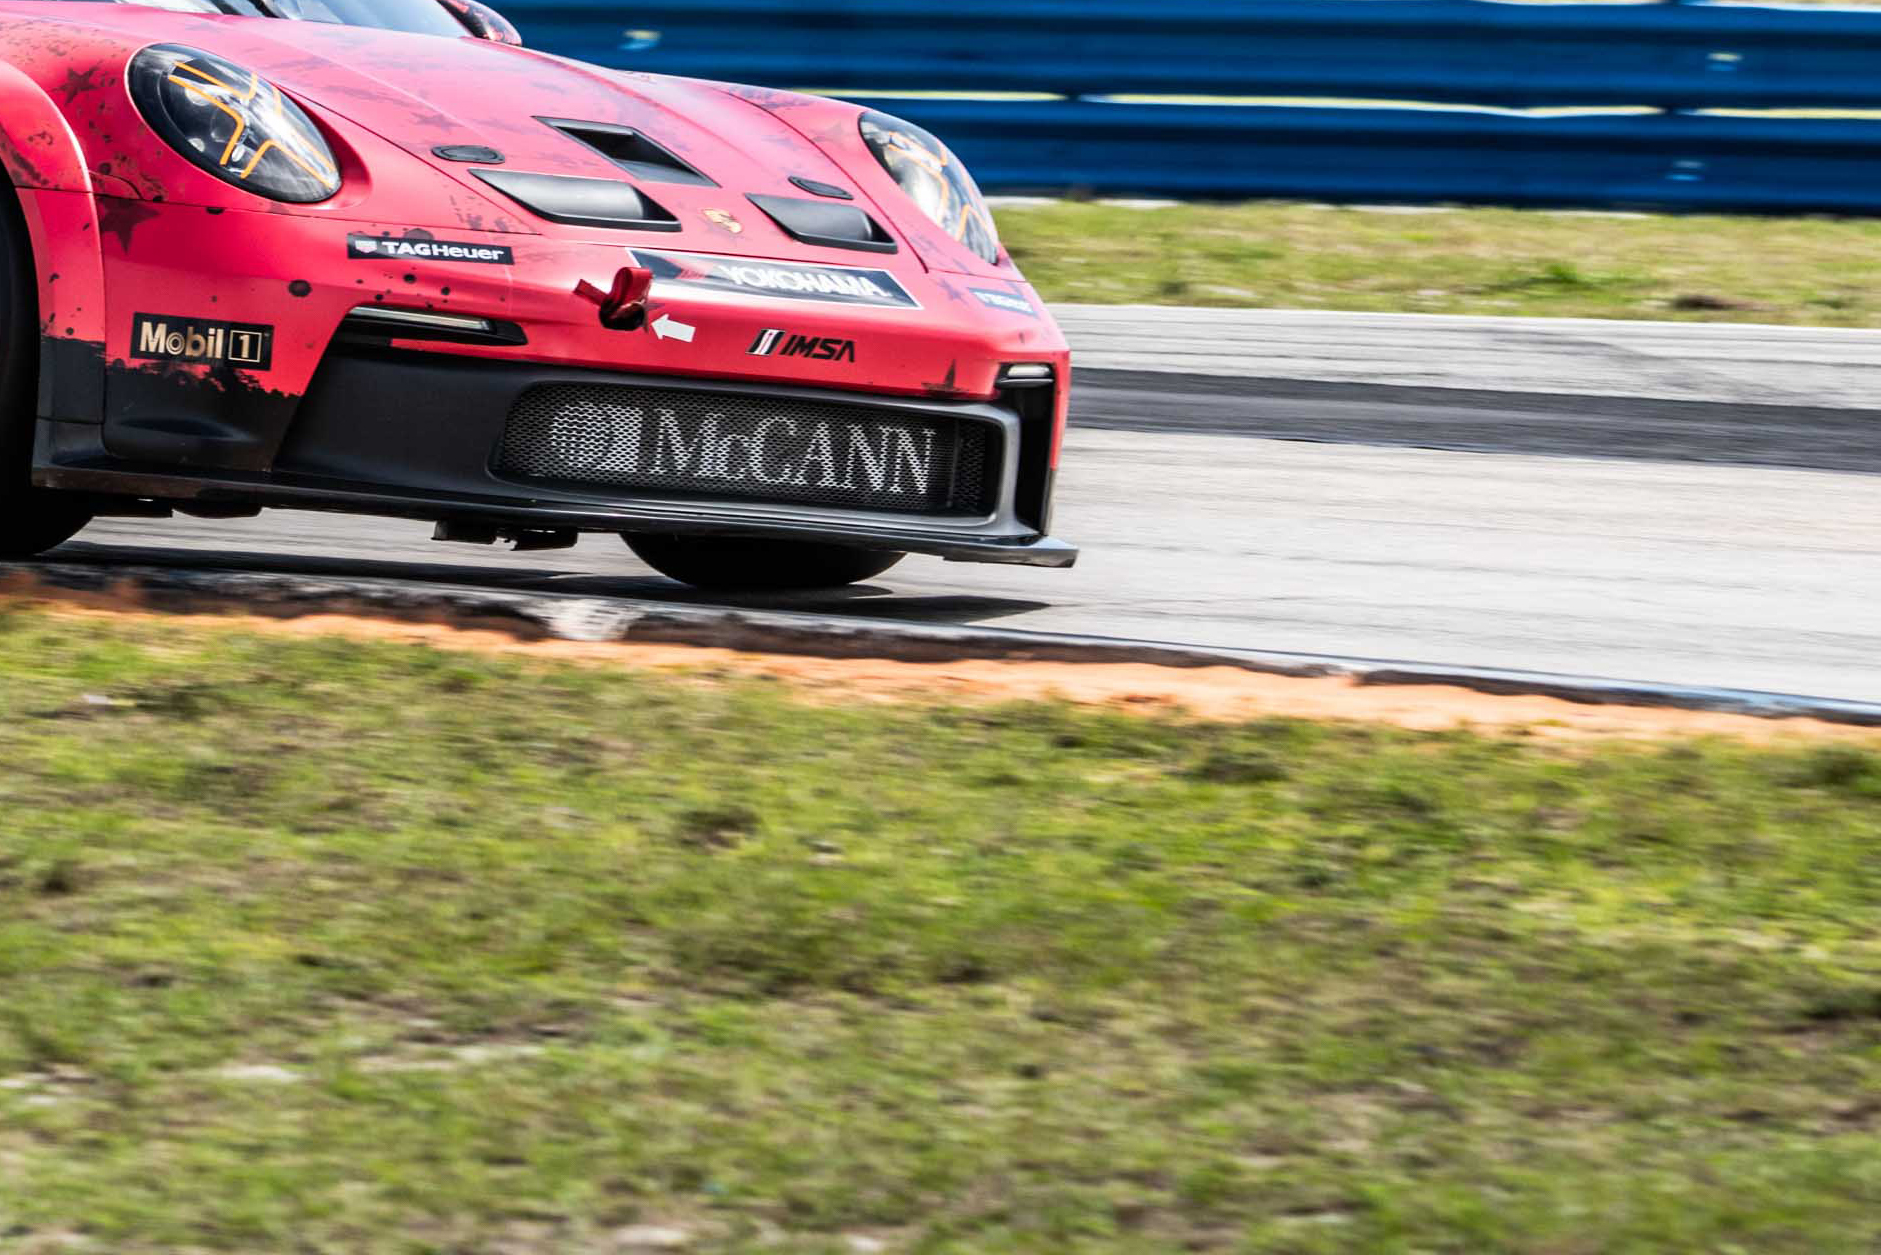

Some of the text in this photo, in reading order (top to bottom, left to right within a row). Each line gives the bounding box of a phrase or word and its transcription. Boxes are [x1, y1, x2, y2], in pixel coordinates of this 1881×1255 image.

[718, 264, 892, 298] YOKOHAMA
[139, 321, 224, 360] Mobil
[778, 333, 856, 363] IMSA
[648, 407, 937, 495] McCANN
